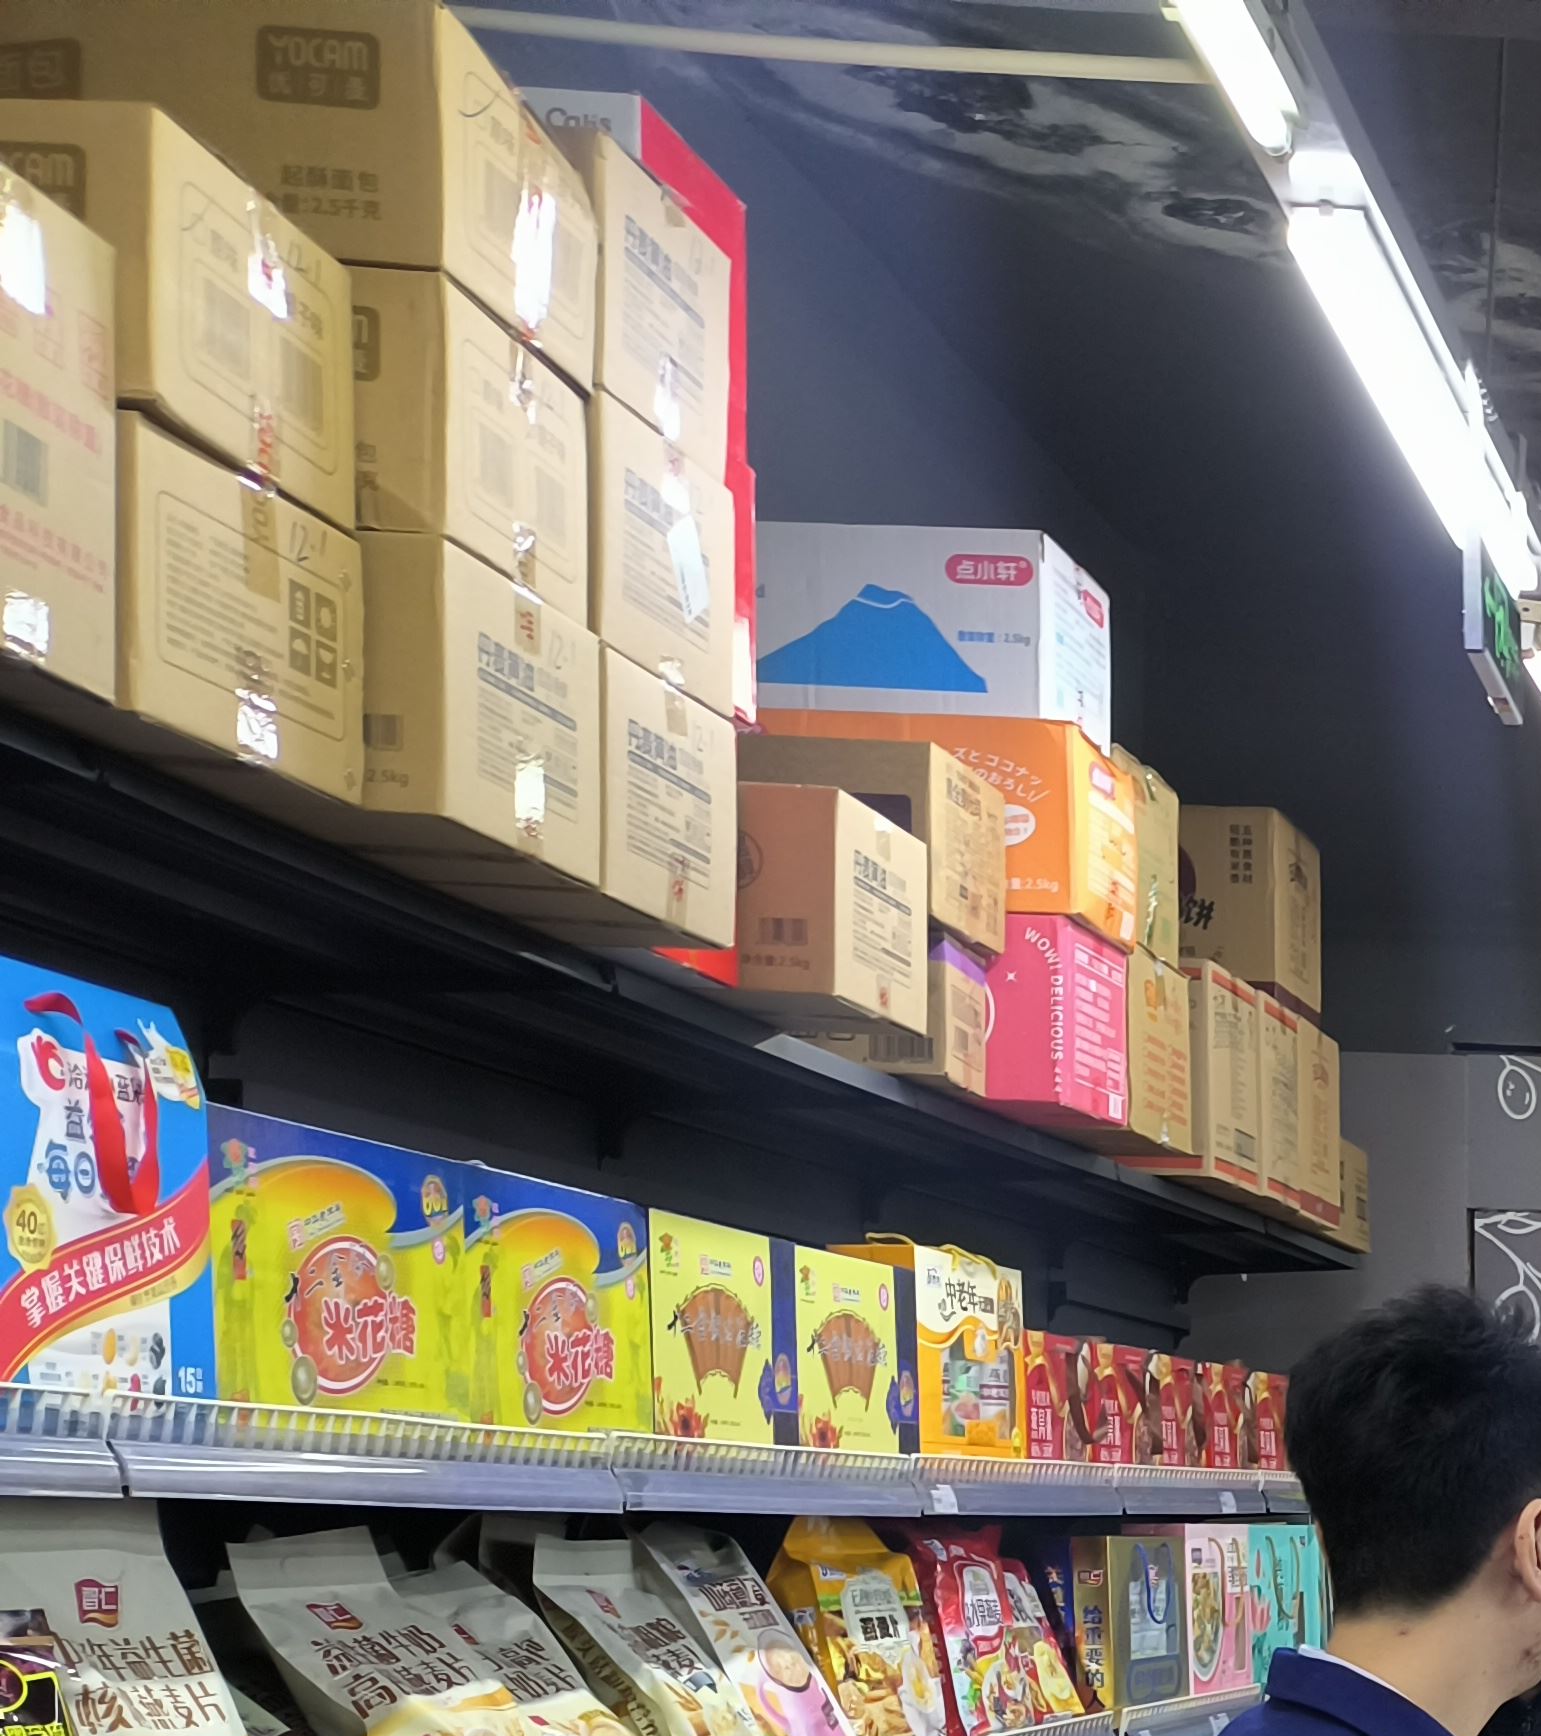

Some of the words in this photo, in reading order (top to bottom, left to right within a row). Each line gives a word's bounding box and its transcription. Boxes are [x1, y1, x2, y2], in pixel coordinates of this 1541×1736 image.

[267, 32, 369, 72] YOCAM
[955, 559, 1019, 582] 点小轩
[1049, 975, 1065, 1062] DELICIOUS
[19, 1215, 182, 1329] 掌握关键保鲜技术
[321, 1294, 417, 1365] 米花糖
[545, 1326, 616, 1388] 米花糖
[74, 1680, 227, 1733] 核燕麦片
